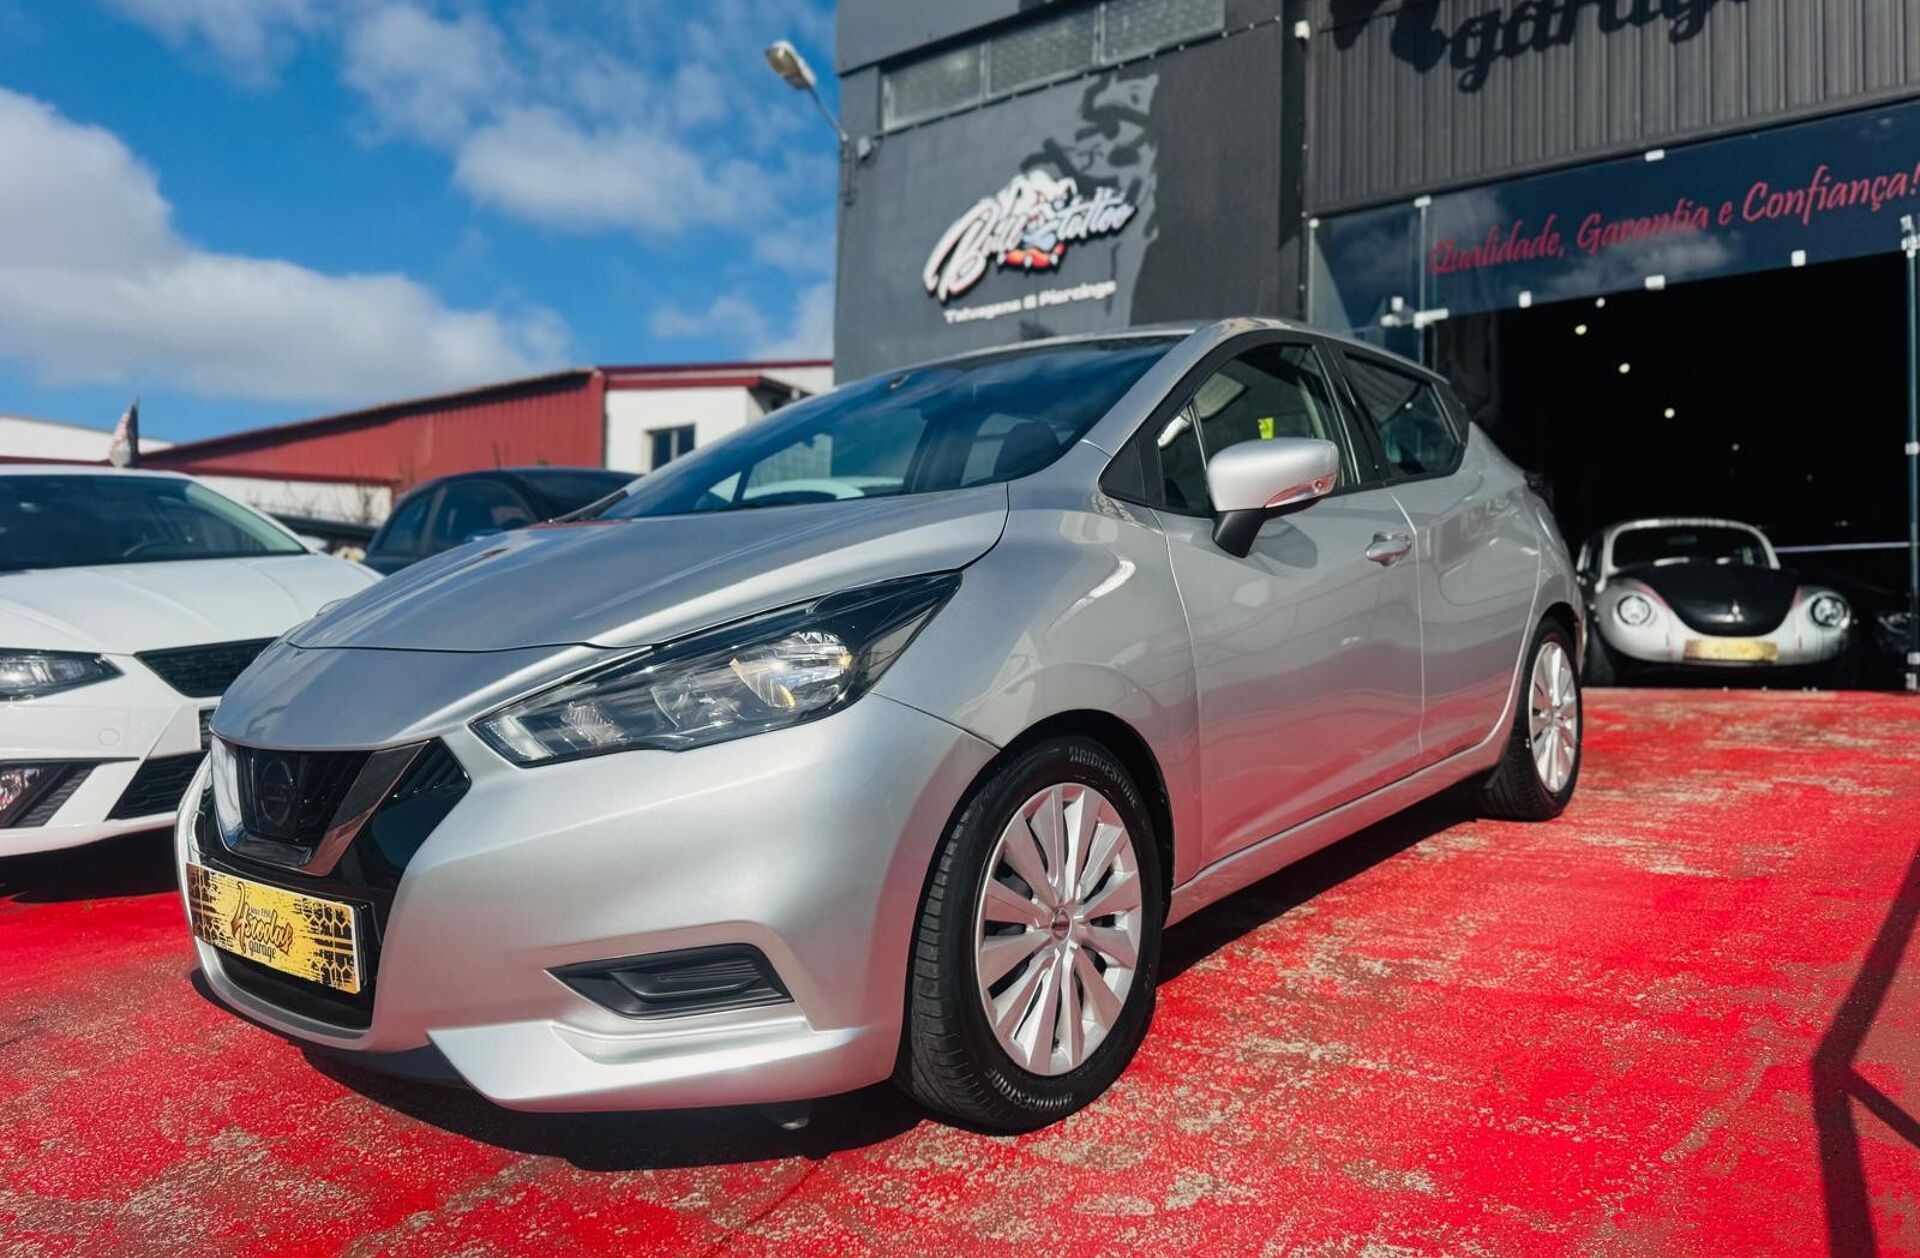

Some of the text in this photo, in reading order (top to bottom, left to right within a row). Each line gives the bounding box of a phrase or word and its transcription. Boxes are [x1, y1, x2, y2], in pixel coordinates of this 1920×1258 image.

[1428, 163, 1920, 275] Qualidade, Garantia e Confiança!
[1067, 744, 1137, 810] BRIDGESTONE
[249, 940, 276, 963] garage
